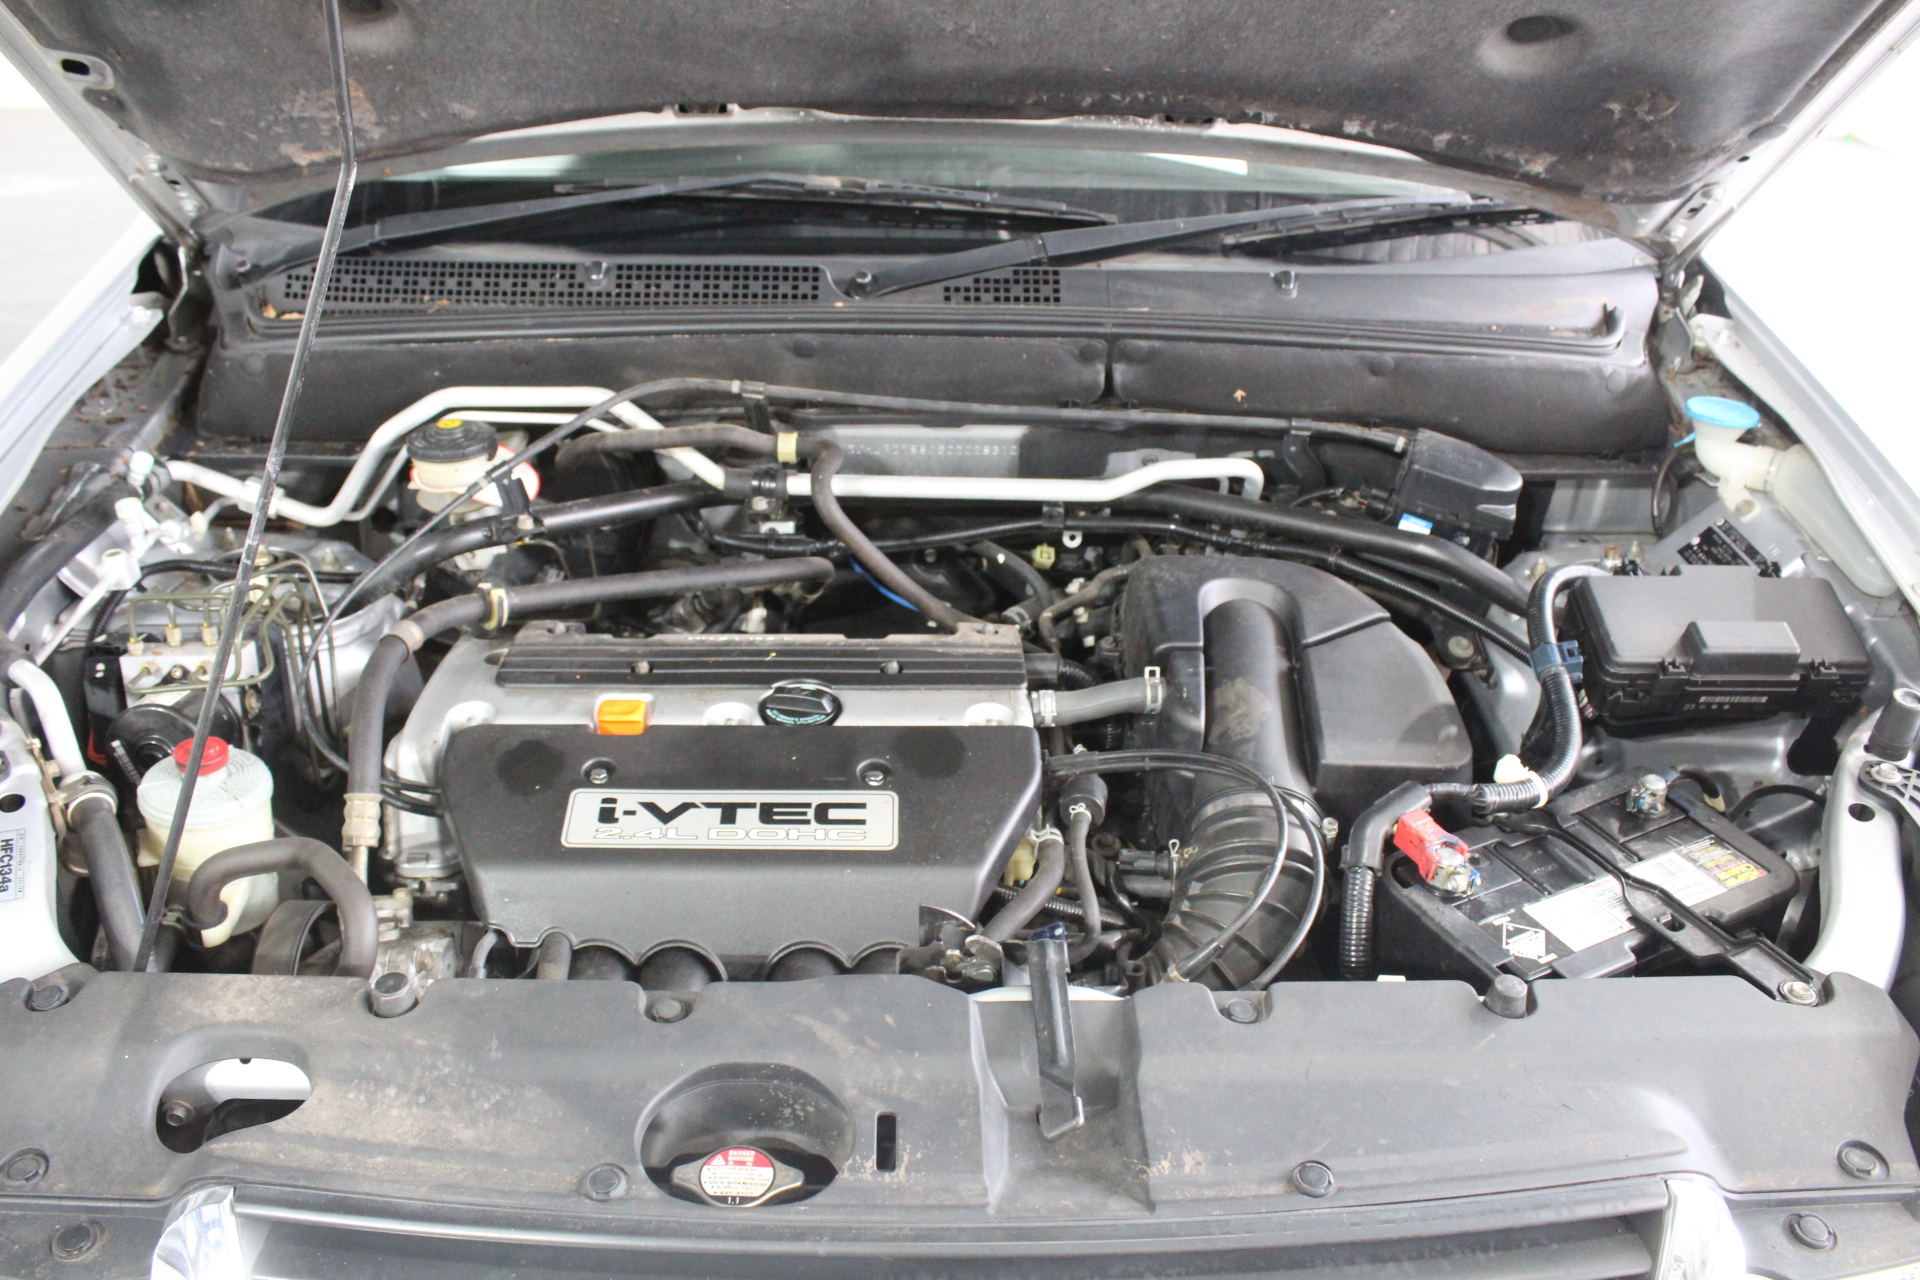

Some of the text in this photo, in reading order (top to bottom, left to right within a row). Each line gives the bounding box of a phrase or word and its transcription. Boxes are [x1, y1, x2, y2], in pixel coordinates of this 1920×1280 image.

[597, 797, 867, 825] i-VTEC
[594, 827, 867, 841] 2.4L DOHC
[0, 838, 14, 893] HFC134a
[727, 1196, 740, 1204] 1.1
